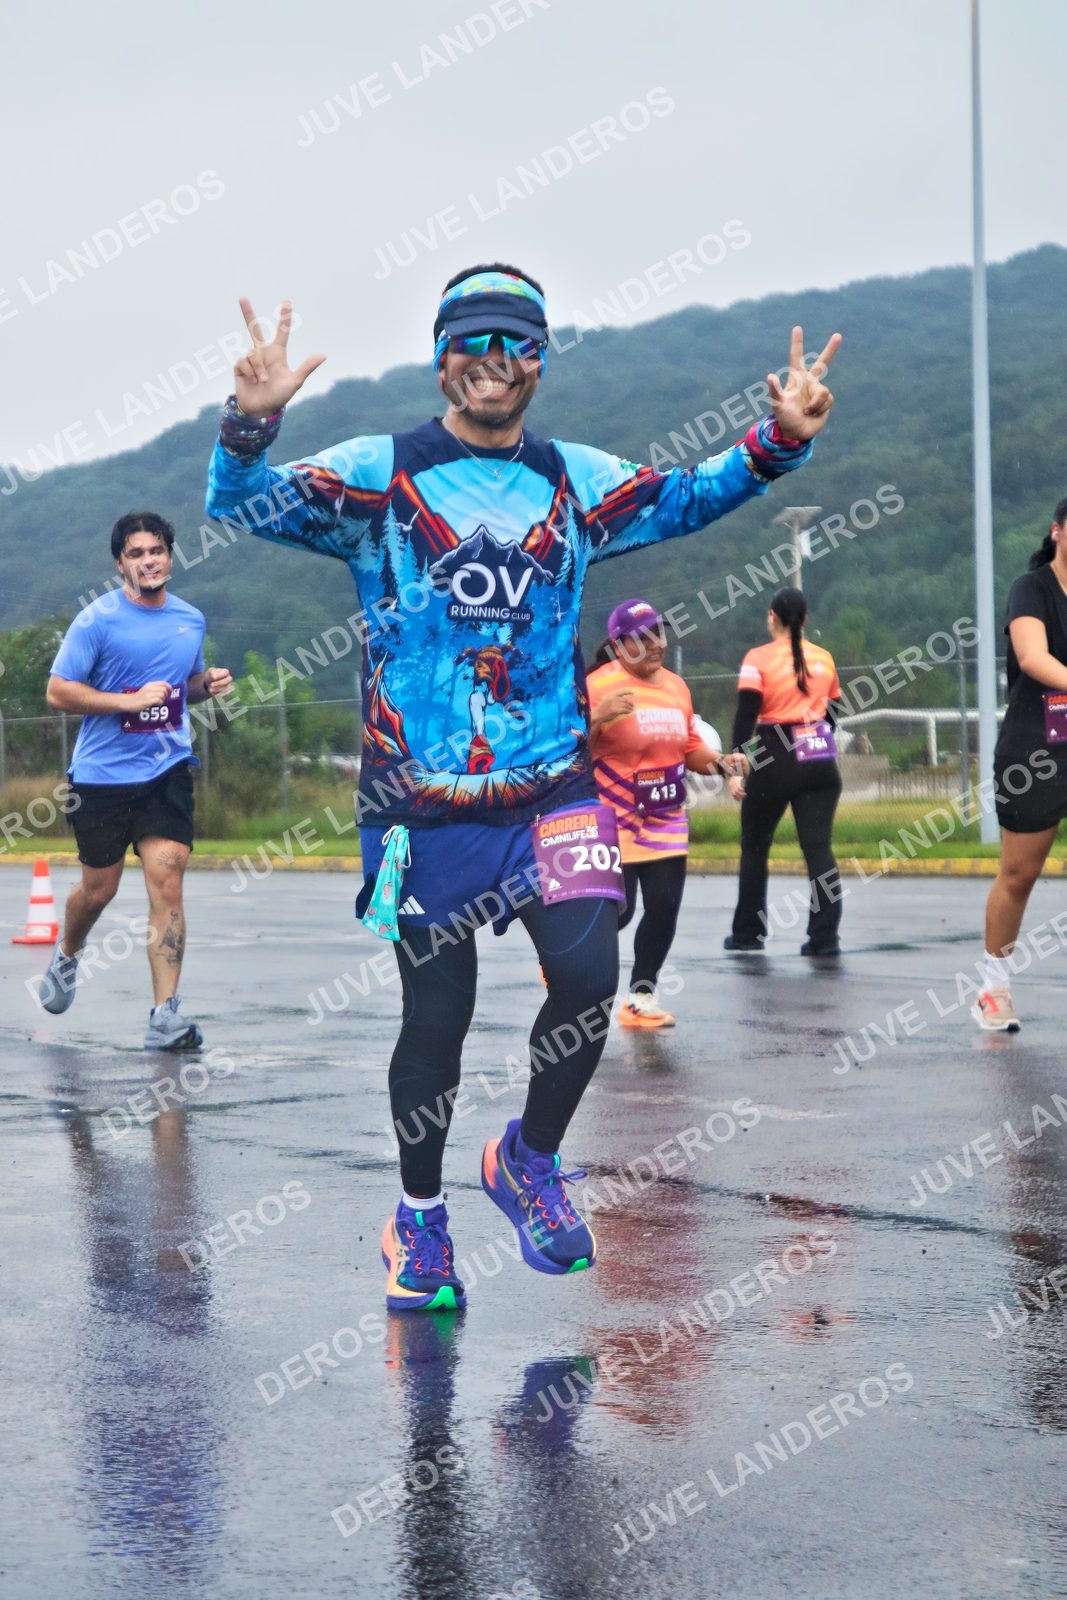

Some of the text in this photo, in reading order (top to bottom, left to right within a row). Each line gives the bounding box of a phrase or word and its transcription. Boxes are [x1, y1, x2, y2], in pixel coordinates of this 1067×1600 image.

[453, 562, 534, 607] OV
[451, 604, 530, 620] RUNNING CLUB
[139, 705, 169, 722] 659
[650, 783, 677, 801] 413
[540, 813, 598, 838] CARRERA
